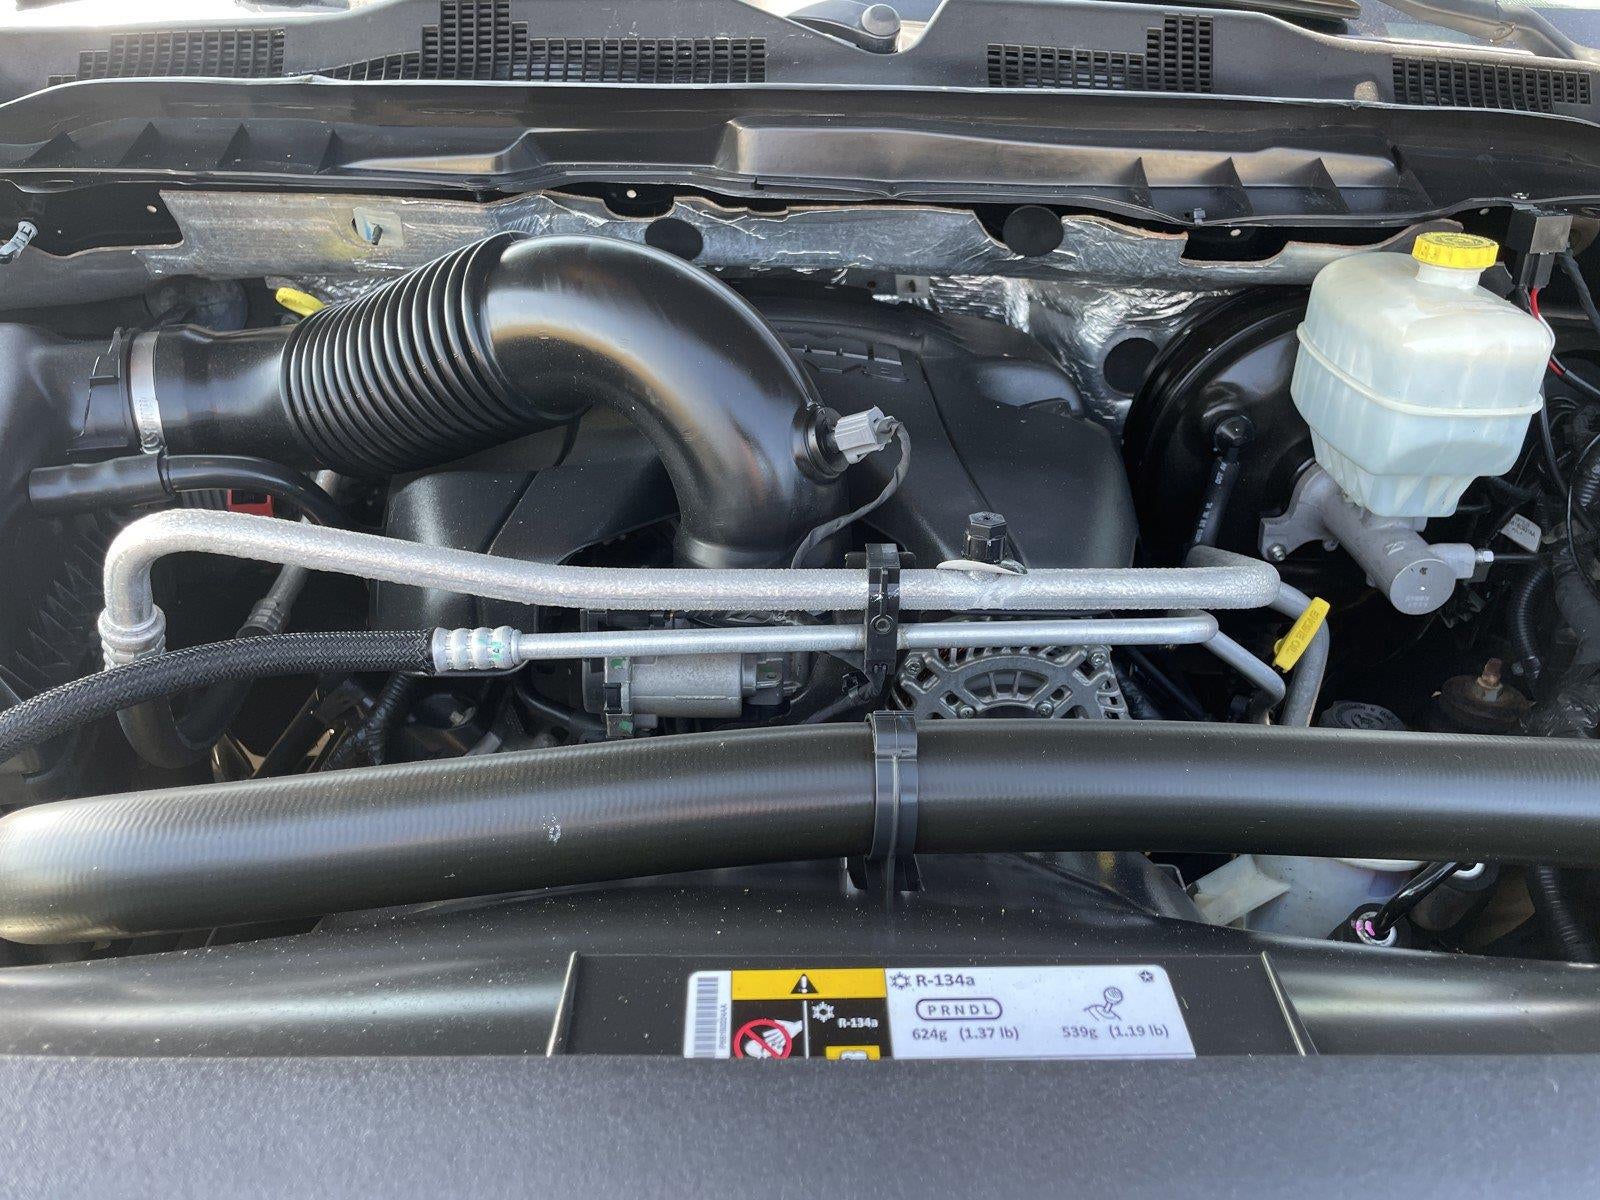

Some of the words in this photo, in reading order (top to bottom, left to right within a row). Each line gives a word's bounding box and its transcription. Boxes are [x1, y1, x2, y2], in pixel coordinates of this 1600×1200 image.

[916, 974, 976, 987] R-134a
[838, 1017, 879, 1029] R-134a
[912, 1028, 948, 1042] 624g
[960, 1026, 995, 1042] (1.37
[1000, 1026, 1019, 1042] lb)
[1062, 1026, 1099, 1039] 539g
[1109, 1025, 1145, 1040] (1.19
[1149, 1024, 1169, 1038] lb)
